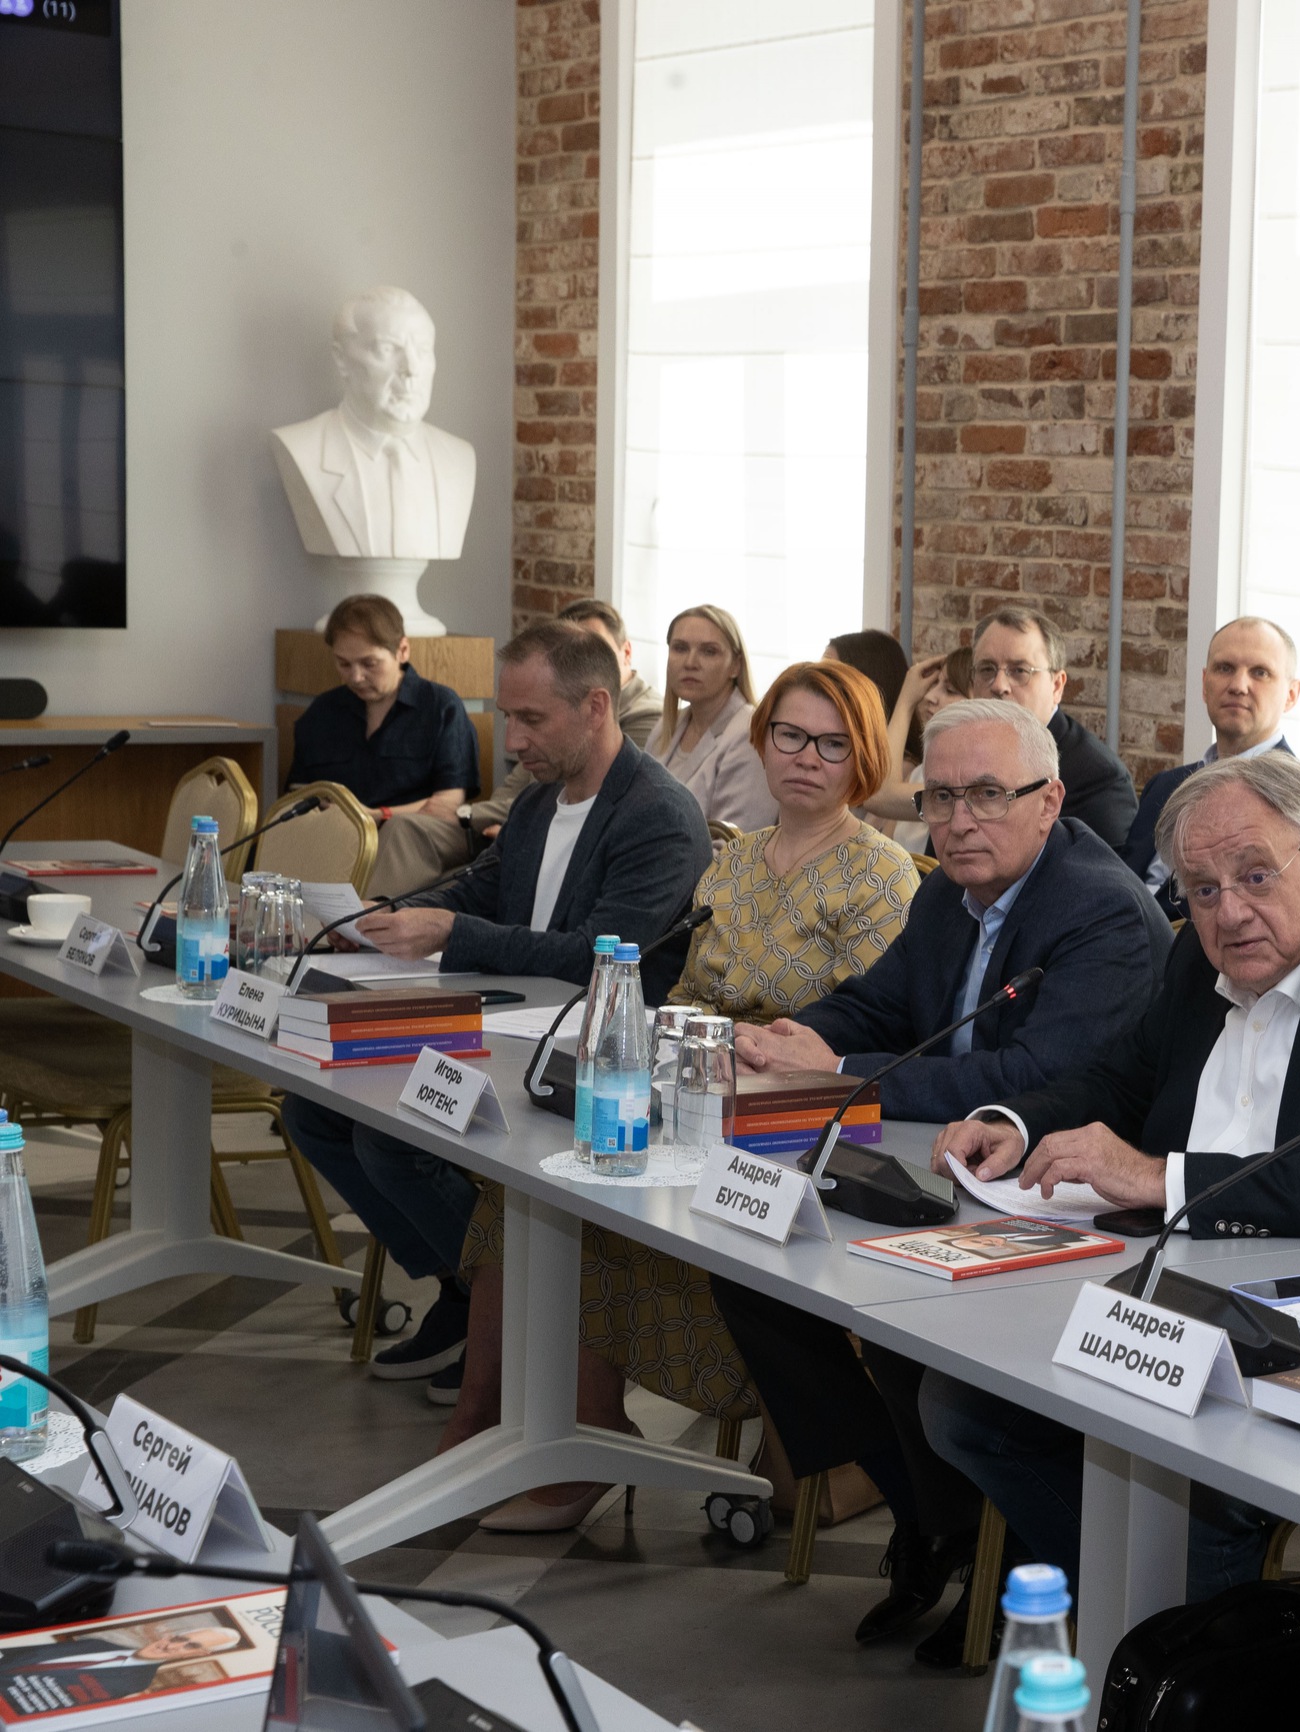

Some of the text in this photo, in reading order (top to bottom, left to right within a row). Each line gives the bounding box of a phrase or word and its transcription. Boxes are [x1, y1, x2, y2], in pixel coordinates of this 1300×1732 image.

[42, 0, 77, 22] (11)
[238, 981, 264, 1003] Елена
[216, 1002, 266, 1032] КУРИЦЫНА
[434, 1058, 463, 1086] Игорь
[416, 1083, 458, 1116] ЮРГЕНС
[727, 1155, 783, 1188] Андрей
[715, 1185, 771, 1220] БУГРОВ
[1105, 1299, 1186, 1344] Андрей
[1078, 1331, 1185, 1387] ШАРОНОВ
[132, 1420, 193, 1475] Сергей
[95, 1468, 192, 1537] ШАКОВ
